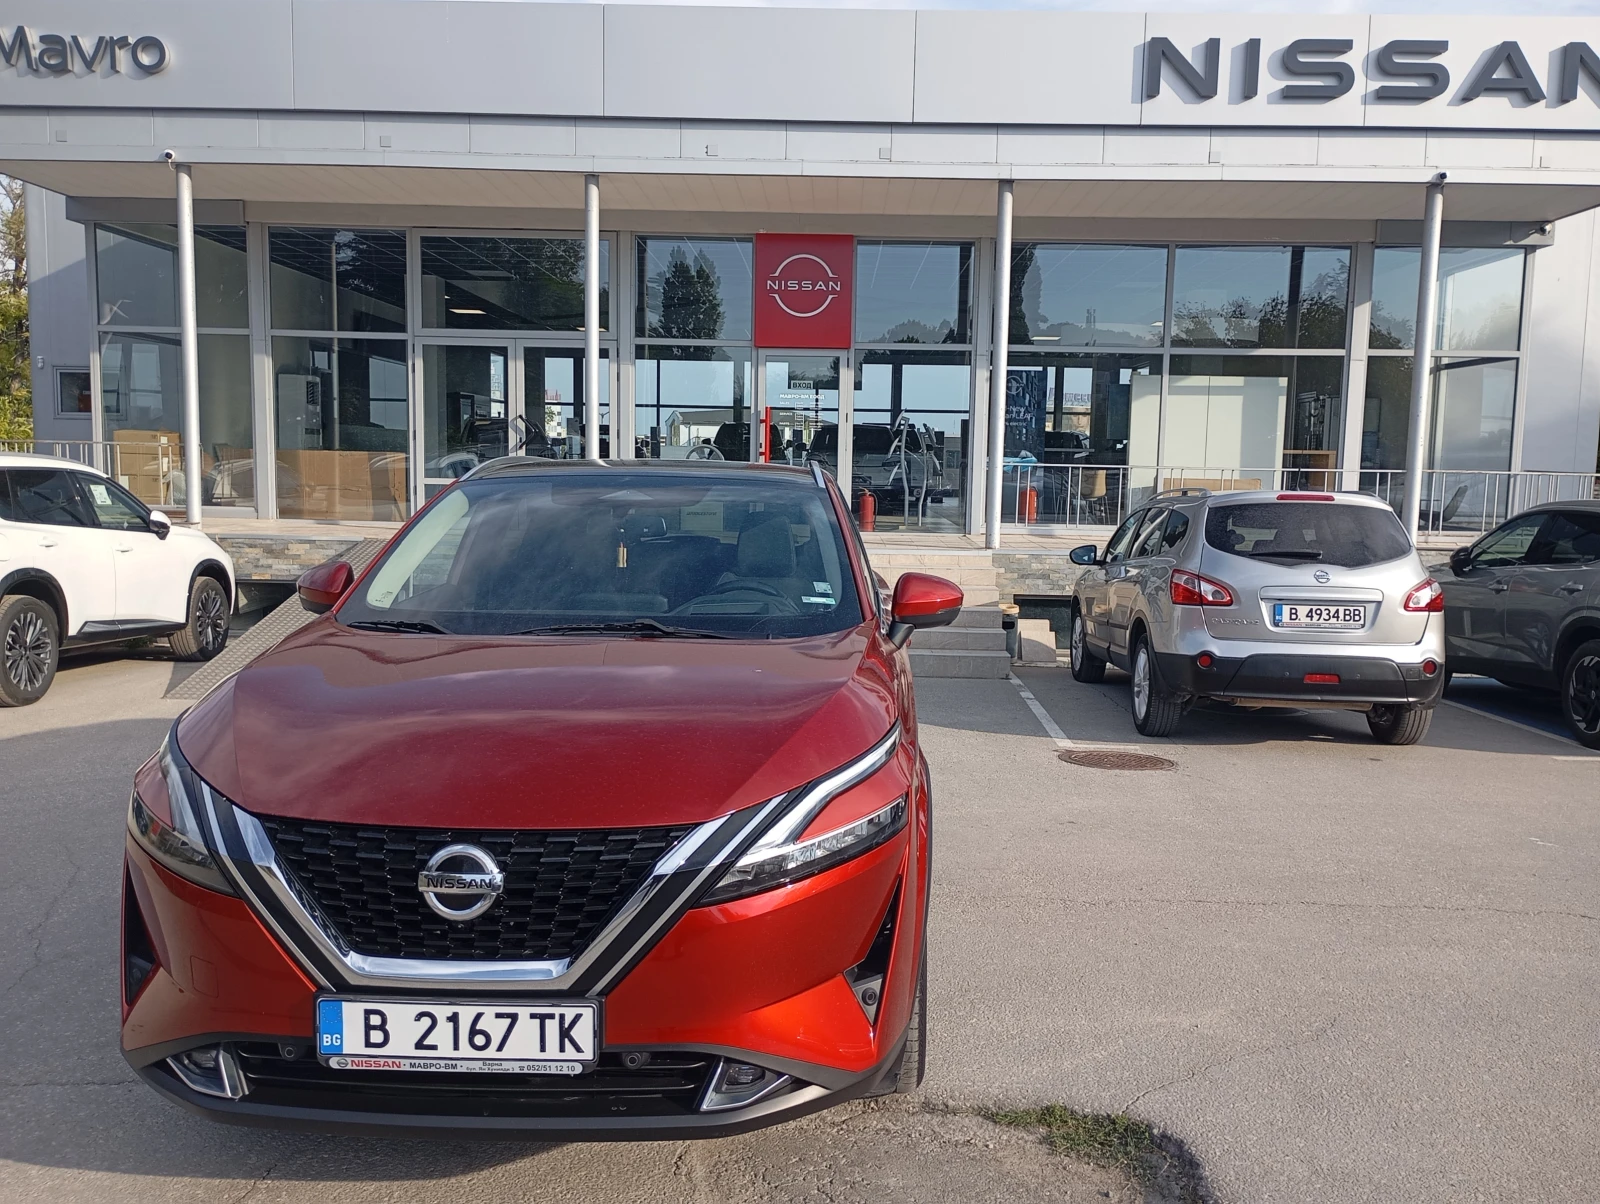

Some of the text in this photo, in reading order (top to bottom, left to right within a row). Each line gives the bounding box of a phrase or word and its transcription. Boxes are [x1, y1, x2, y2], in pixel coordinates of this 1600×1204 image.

[767, 280, 840, 291] NISSAN
[427, 877, 492, 889] NISSAN
[363, 1008, 585, 1053] B 2167 TK
[322, 1034, 341, 1046] BG
[350, 1059, 402, 1069] NISSAN
[409, 1062, 458, 1070] МАВРО-ВМ
[526, 1064, 552, 1072] 052/51
